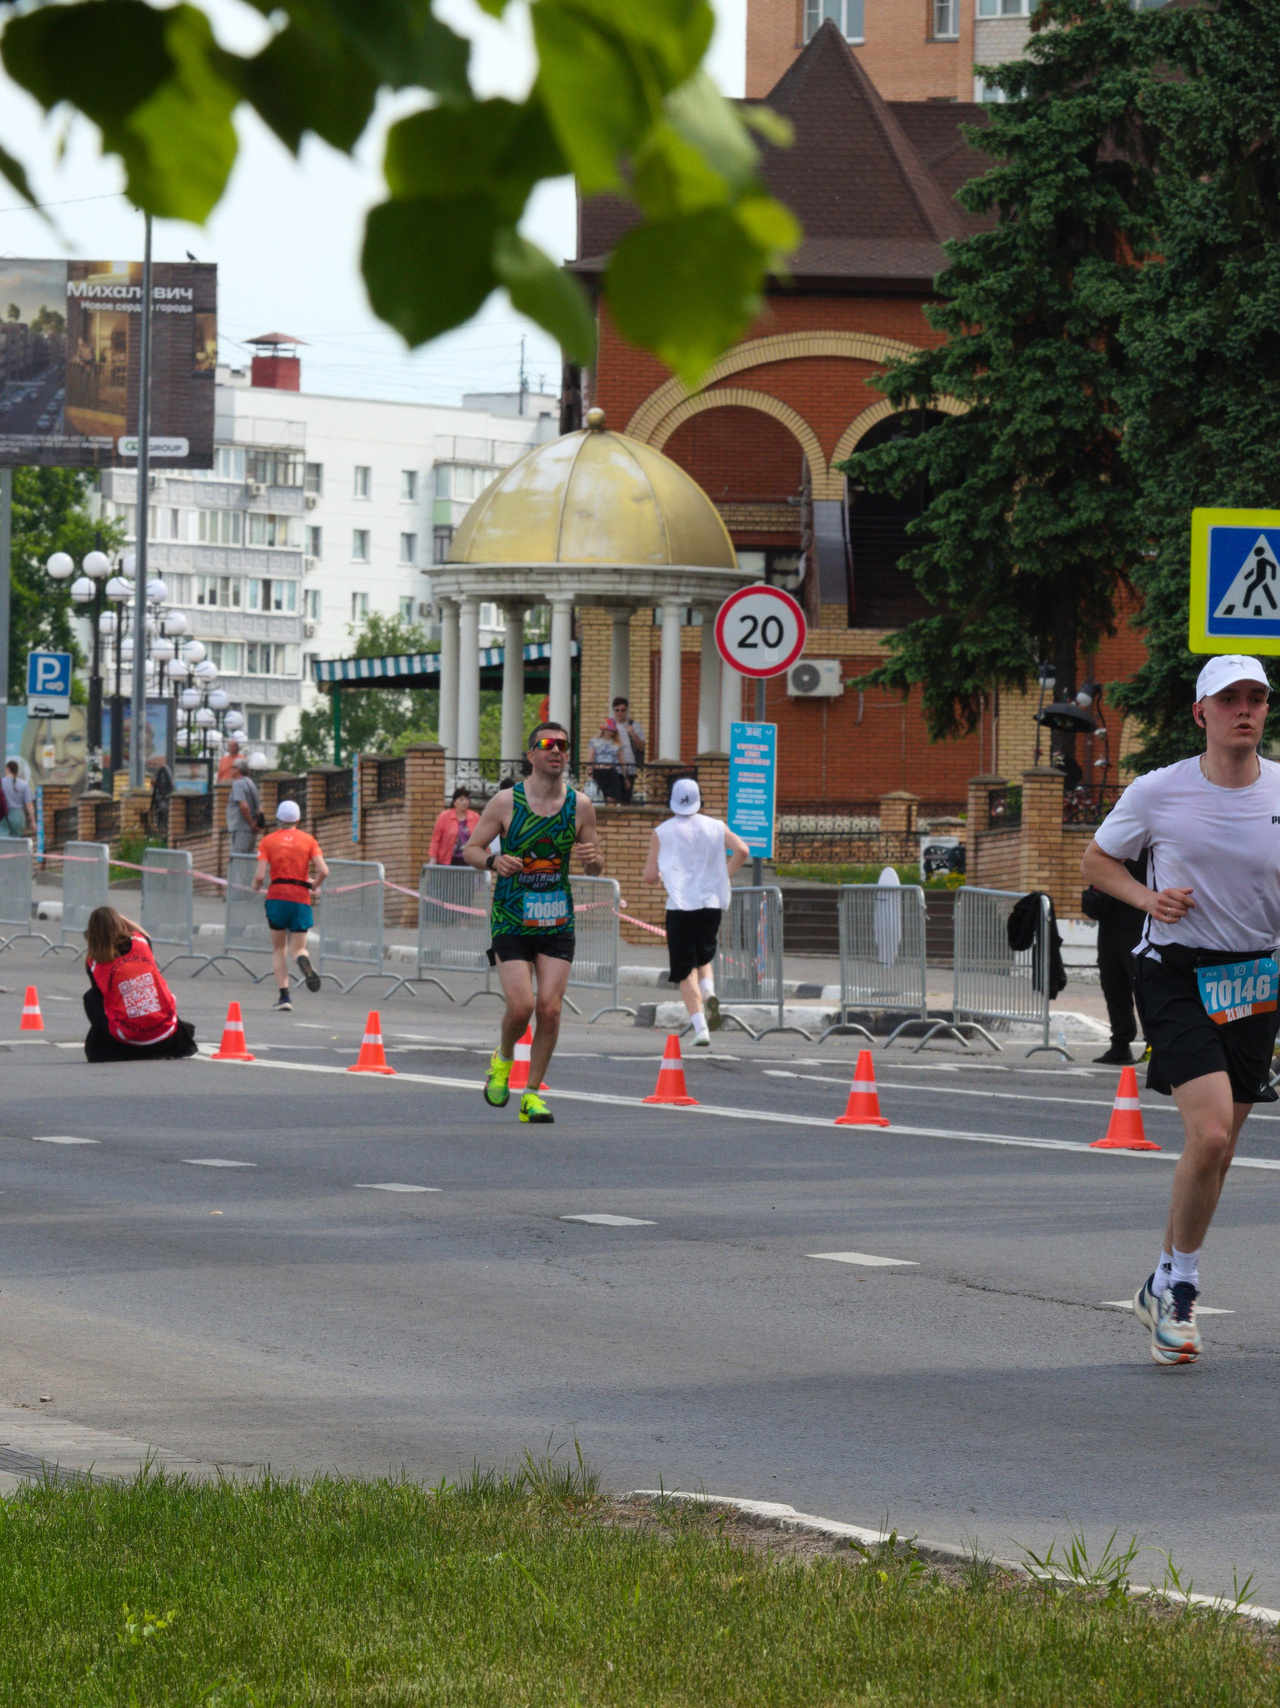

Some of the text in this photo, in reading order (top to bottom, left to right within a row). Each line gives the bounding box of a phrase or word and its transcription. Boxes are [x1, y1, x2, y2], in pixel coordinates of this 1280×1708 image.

[67, 281, 193, 300] Михалвич
[737, 615, 784, 649] 20
[527, 901, 566, 918] 70080
[1206, 975, 1270, 1010] 70146
